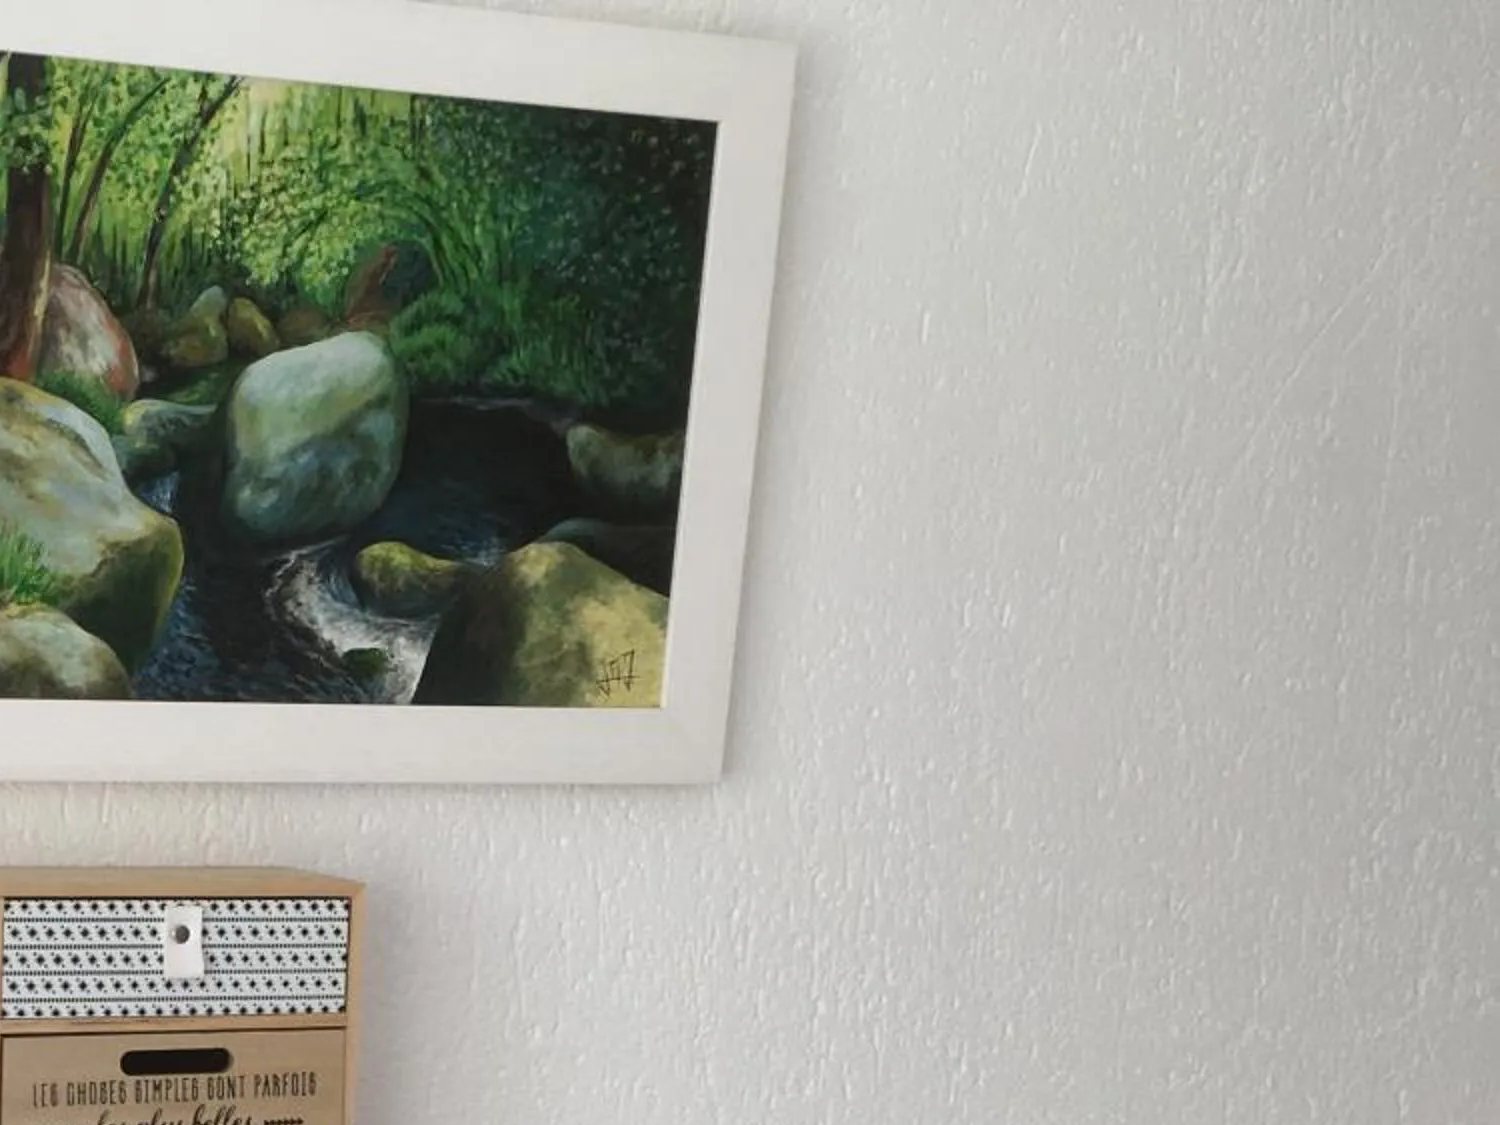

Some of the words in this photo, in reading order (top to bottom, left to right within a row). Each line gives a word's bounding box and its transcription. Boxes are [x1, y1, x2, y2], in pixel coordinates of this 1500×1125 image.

[32, 1083, 59, 1107] LES
[67, 1080, 127, 1105] CHOSES
[135, 1077, 199, 1104] SIMPLES
[206, 1075, 245, 1100] SONT
[253, 1071, 317, 1098] PARFOIS
